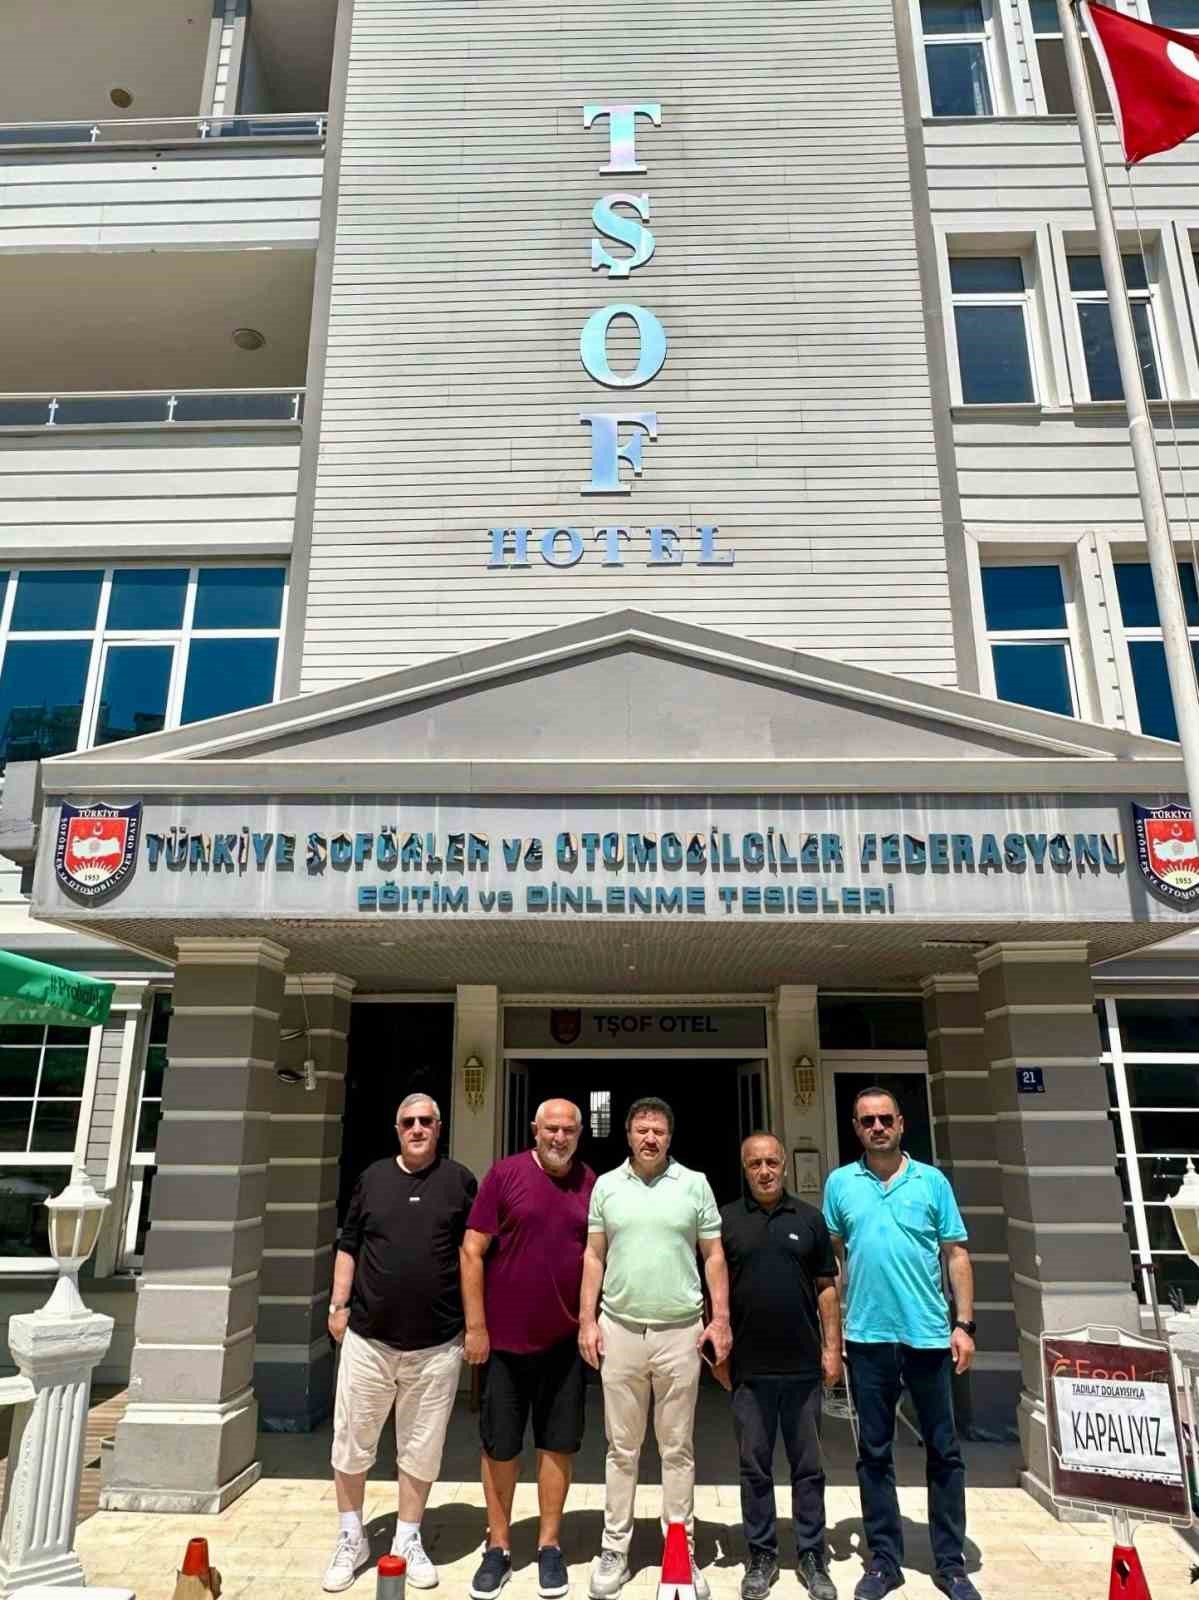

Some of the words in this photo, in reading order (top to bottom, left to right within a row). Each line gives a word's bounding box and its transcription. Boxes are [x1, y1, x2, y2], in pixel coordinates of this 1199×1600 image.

[580, 103, 667, 498] TŞOF
[487, 525, 735, 570] HOTEL
[145, 826, 297, 873] TÜRKİYE
[858, 832, 1126, 875] FEDERASYONU
[479, 890, 513, 912] ve
[526, 880, 706, 913] DİNLENME
[594, 1015, 652, 1038] TŞOF
[659, 1015, 719, 1033] OTEL
[1022, 1071, 1036, 1084] 21
[1071, 1410, 1167, 1457] KAPALIYIZ
